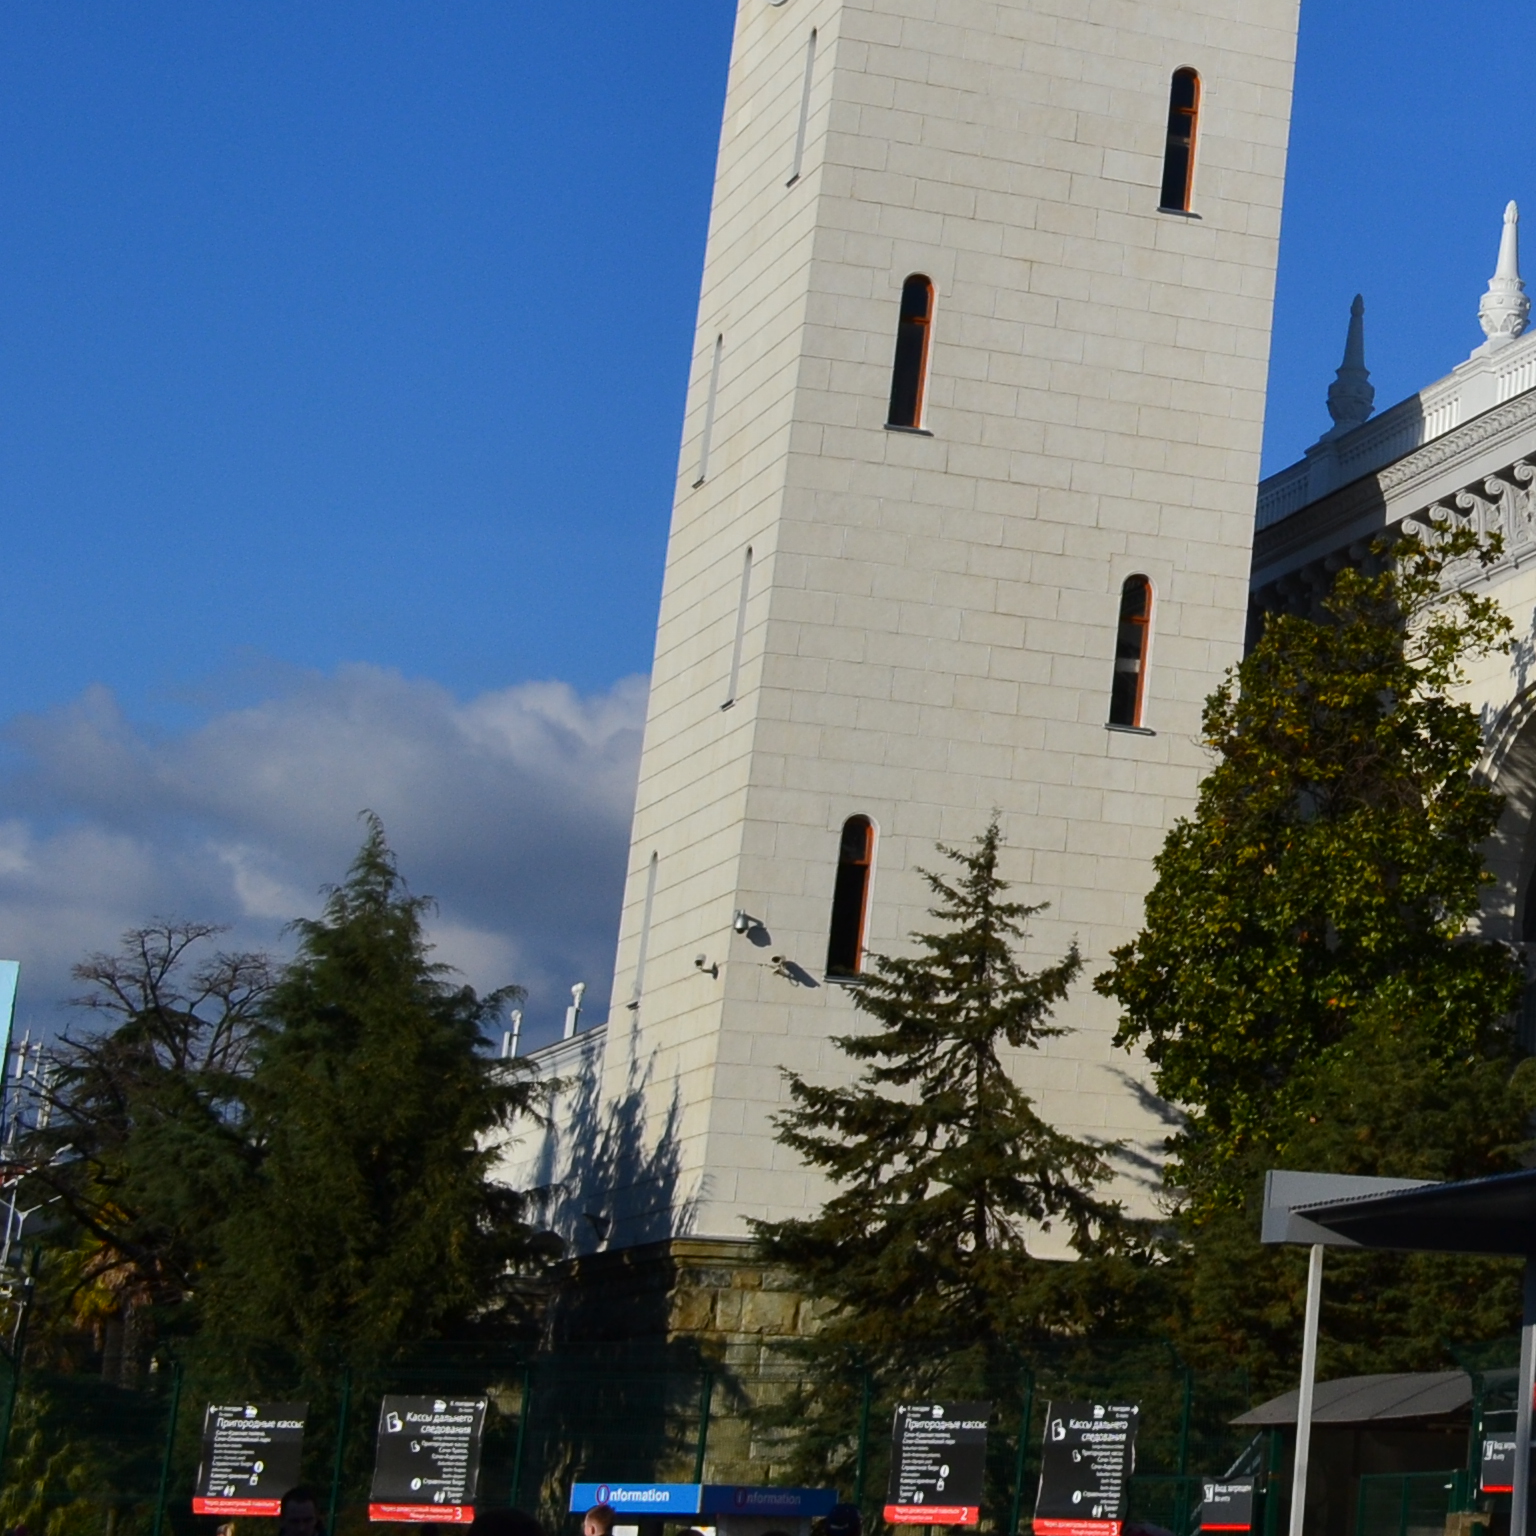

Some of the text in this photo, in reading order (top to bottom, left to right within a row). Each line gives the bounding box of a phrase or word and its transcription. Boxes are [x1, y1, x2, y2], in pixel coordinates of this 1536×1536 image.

[600, 1488, 670, 1502] information
[455, 1506, 462, 1519] 3
[961, 1507, 968, 1521] 2
[1112, 1522, 1117, 1536] 3
